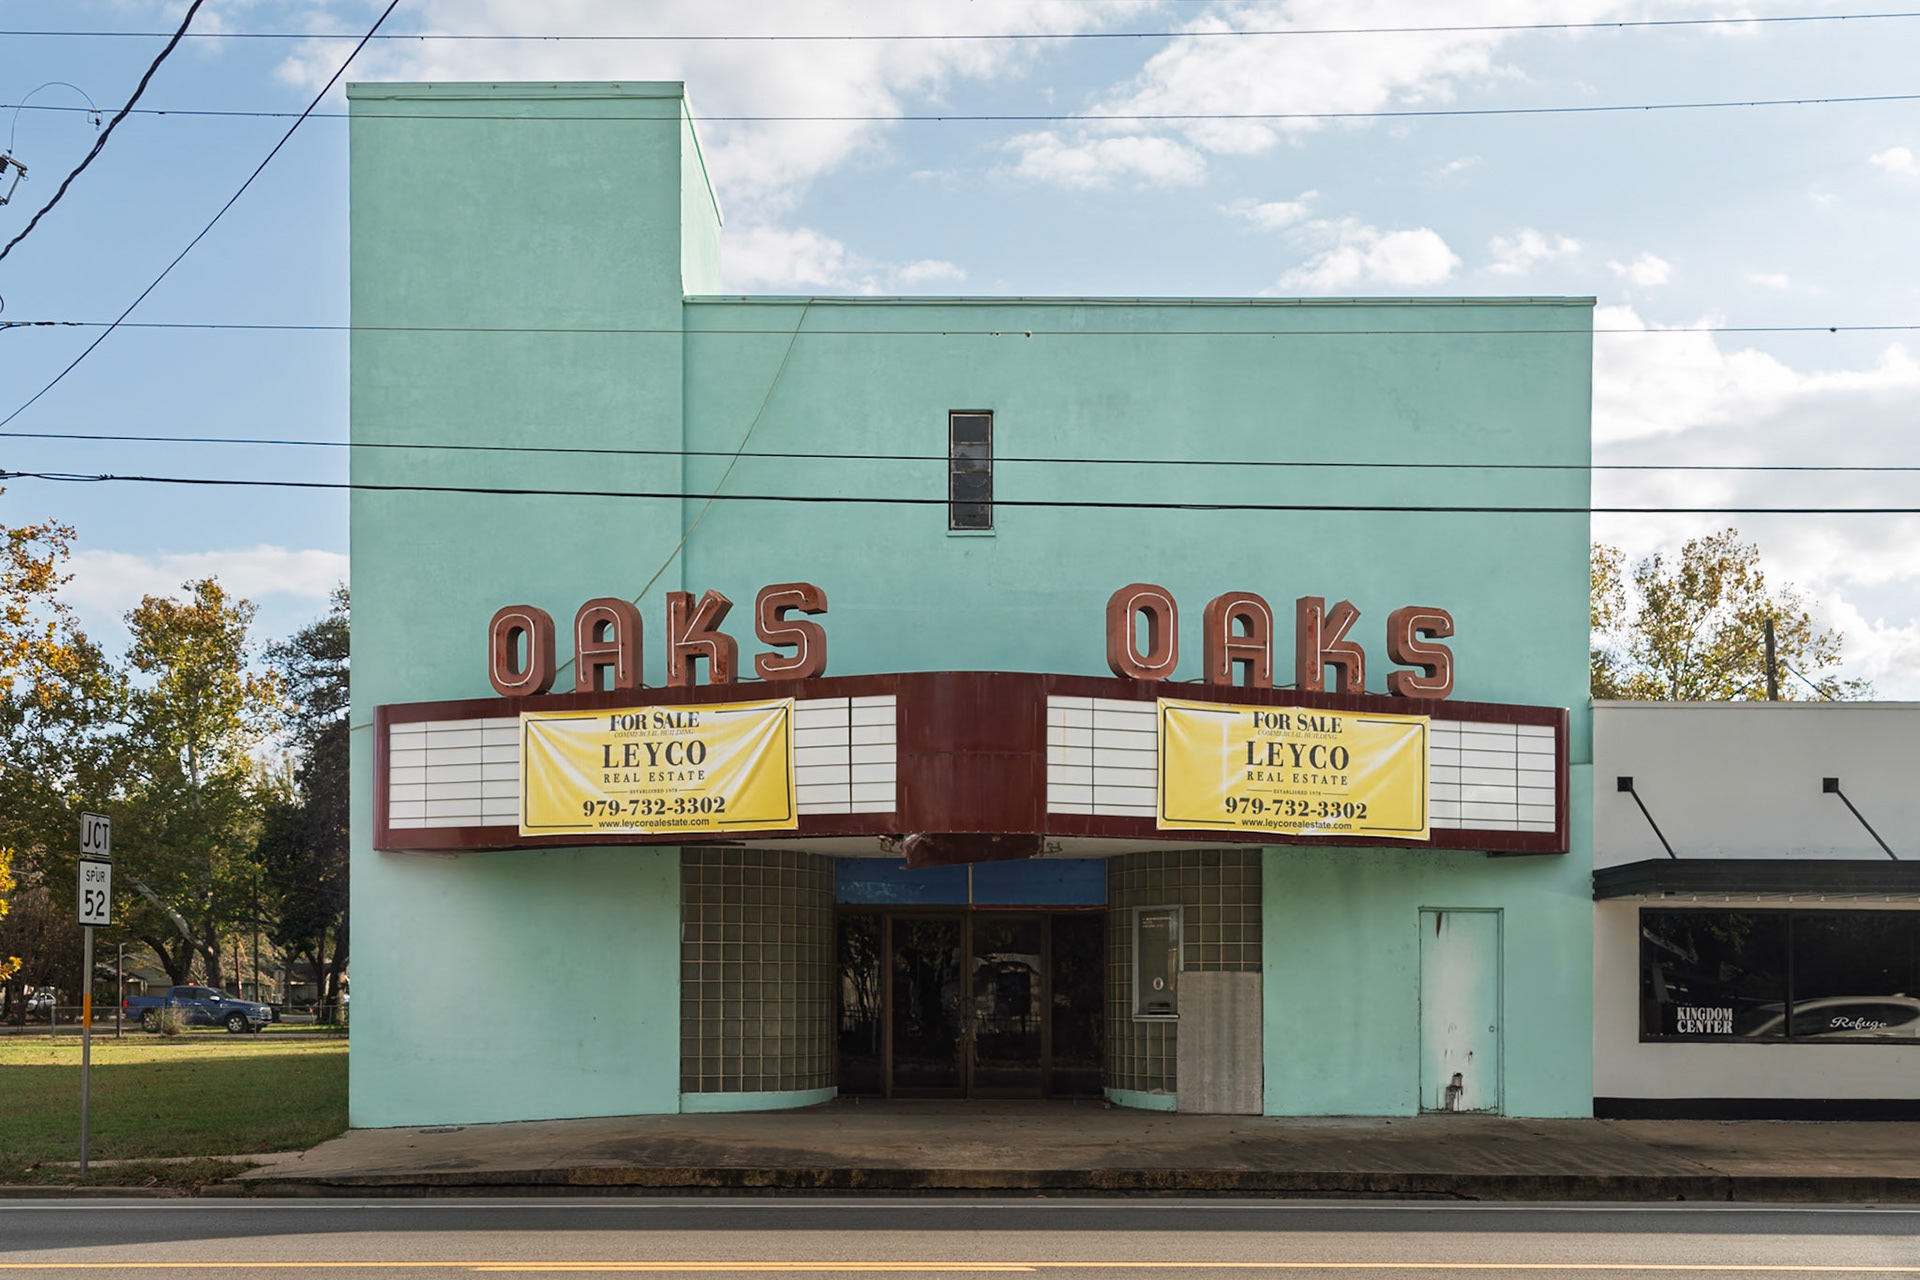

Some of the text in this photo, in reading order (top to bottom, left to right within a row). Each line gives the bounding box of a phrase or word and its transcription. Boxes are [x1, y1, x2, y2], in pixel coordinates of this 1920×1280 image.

[489, 582, 827, 697] OAKS
[1106, 583, 1454, 699] OAKS
[609, 711, 700, 731] FOR SALE
[1253, 711, 1343, 734] FOR SALE
[660, 729, 694, 737] BUILDING
[1304, 732, 1338, 740] BUILDING
[602, 740, 706, 768] LEYCO
[1246, 740, 1349, 771] LEYCO
[603, 770, 705, 783] REAL ESTATE
[1247, 771, 1348, 785] REAL ESTATE
[583, 796, 726, 817] 979-732-3302
[1225, 796, 1367, 819] 979-732-3302
[599, 818, 710, 829] www.leycorealestate.com
[1241, 818, 1352, 830] www.leycorealestate.com
[83, 821, 109, 850] JCT
[86, 870, 106, 883] SPUR
[84, 889, 105, 917] 52
[1677, 1006, 1733, 1021] KINGDOM
[1677, 1020, 1733, 1034] CENTER
[1829, 1016, 1887, 1031] Refuge
